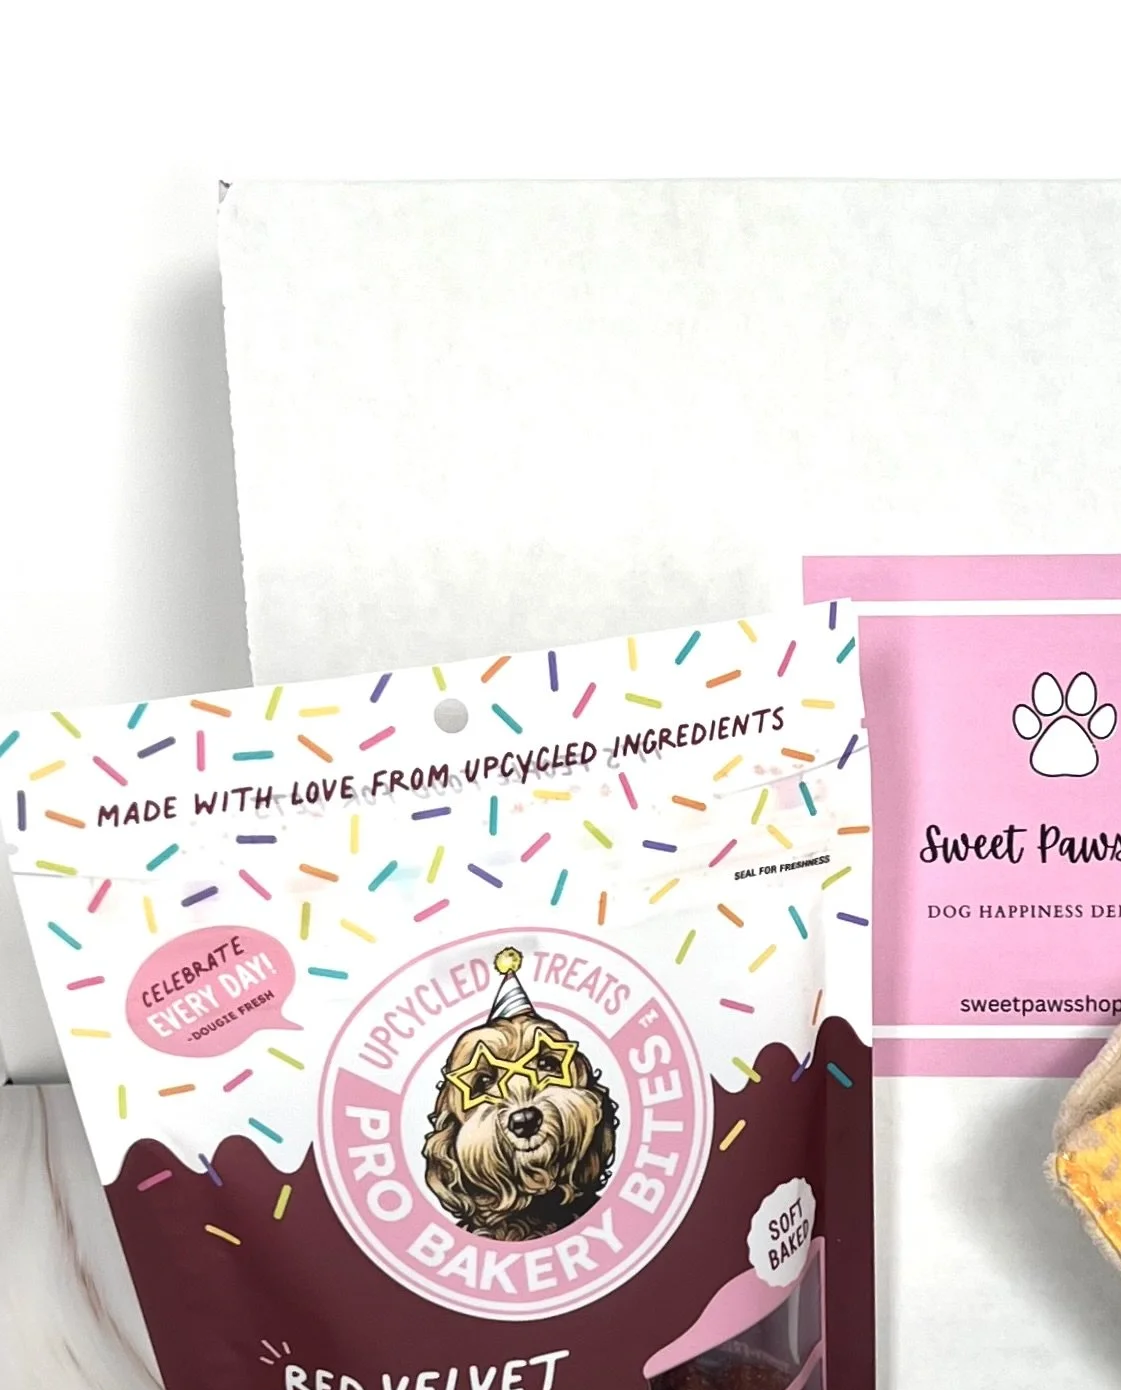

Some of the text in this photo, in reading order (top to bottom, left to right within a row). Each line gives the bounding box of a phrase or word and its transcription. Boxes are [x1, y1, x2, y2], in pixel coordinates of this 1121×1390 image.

[97, 706, 785, 828] MADE WITH LOVE FROM UPCYCLED INGREDIENTS
[734, 854, 831, 881] SEAL FOR FRESHNESS
[919, 823, 1027, 864] Sweet
[927, 904, 972, 919] DOG
[979, 904, 1084, 919] HAPPINESS
[142, 935, 245, 1008] CELEBRATE
[146, 952, 278, 1038] EVERY DAY!
[237, 989, 276, 1016] FRESH
[358, 950, 632, 1071] UPCYCLED TREATS
[344, 1104, 414, 1223] PRO
[405, 1207, 624, 1295] BAKERY
[619, 1033, 685, 1216] BITES
[768, 1197, 803, 1241] SOFT
[768, 1218, 809, 1271] BAKED
